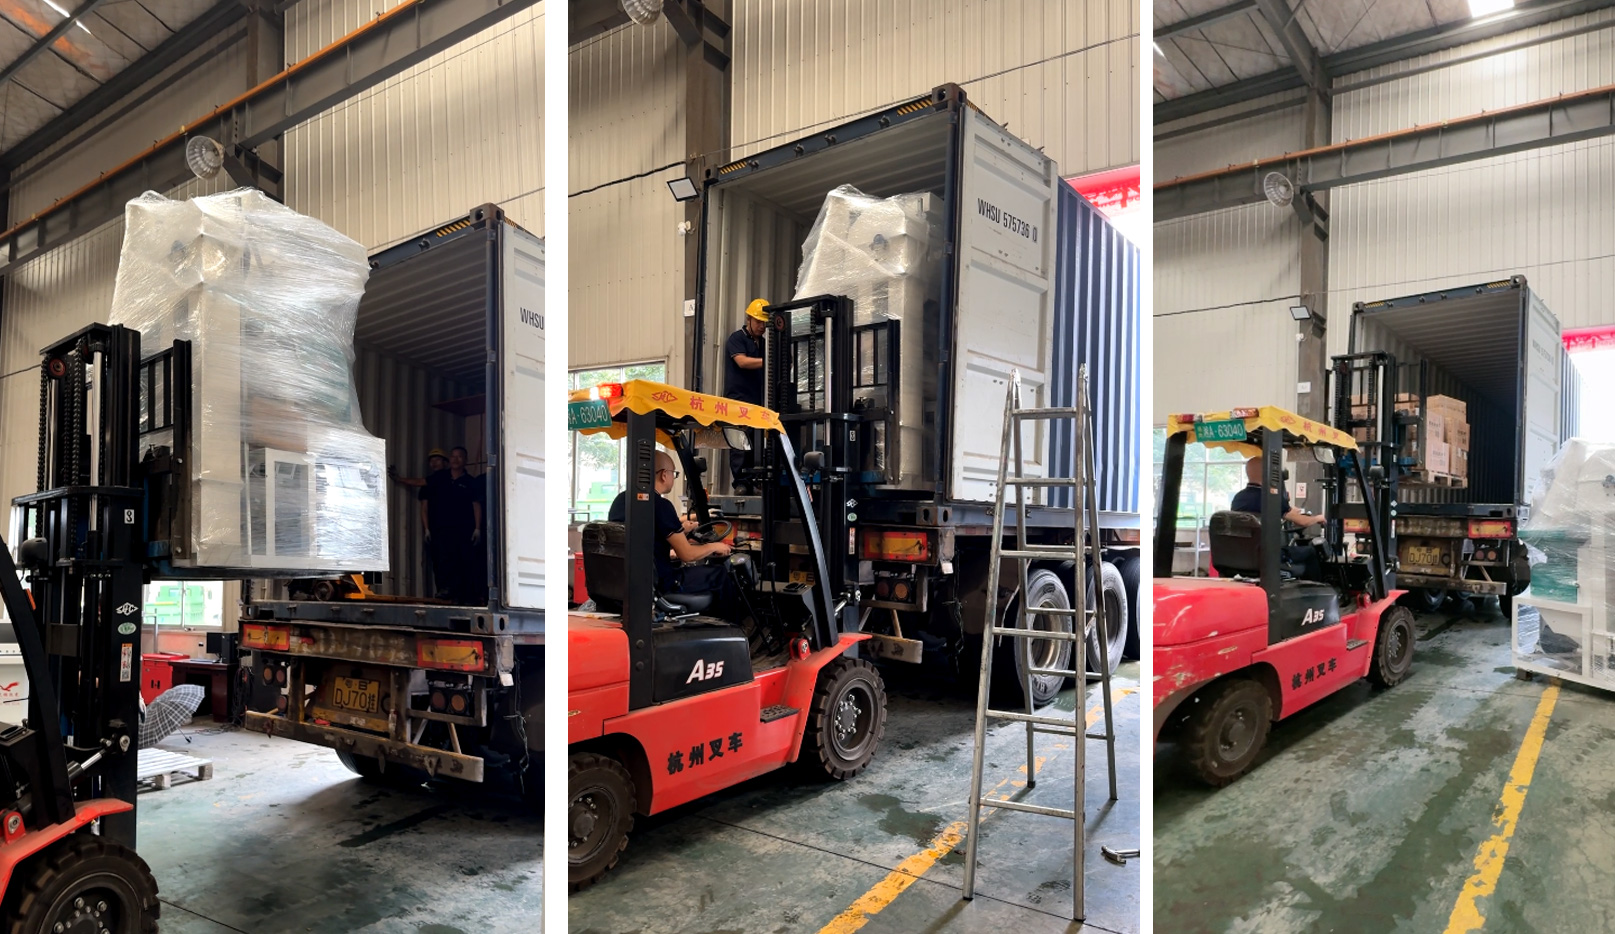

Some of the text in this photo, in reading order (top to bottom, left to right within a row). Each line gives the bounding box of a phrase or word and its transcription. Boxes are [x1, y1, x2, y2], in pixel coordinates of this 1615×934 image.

[977, 197, 1001, 224] WHSU
[1003, 211, 1030, 239] 575736
[519, 306, 544, 331] WHSU
[1300, 607, 1325, 627] A35
[685, 658, 725, 685] A35
[1291, 657, 1337, 691] 杭州叉车
[666, 731, 743, 776] 杭州叉车
